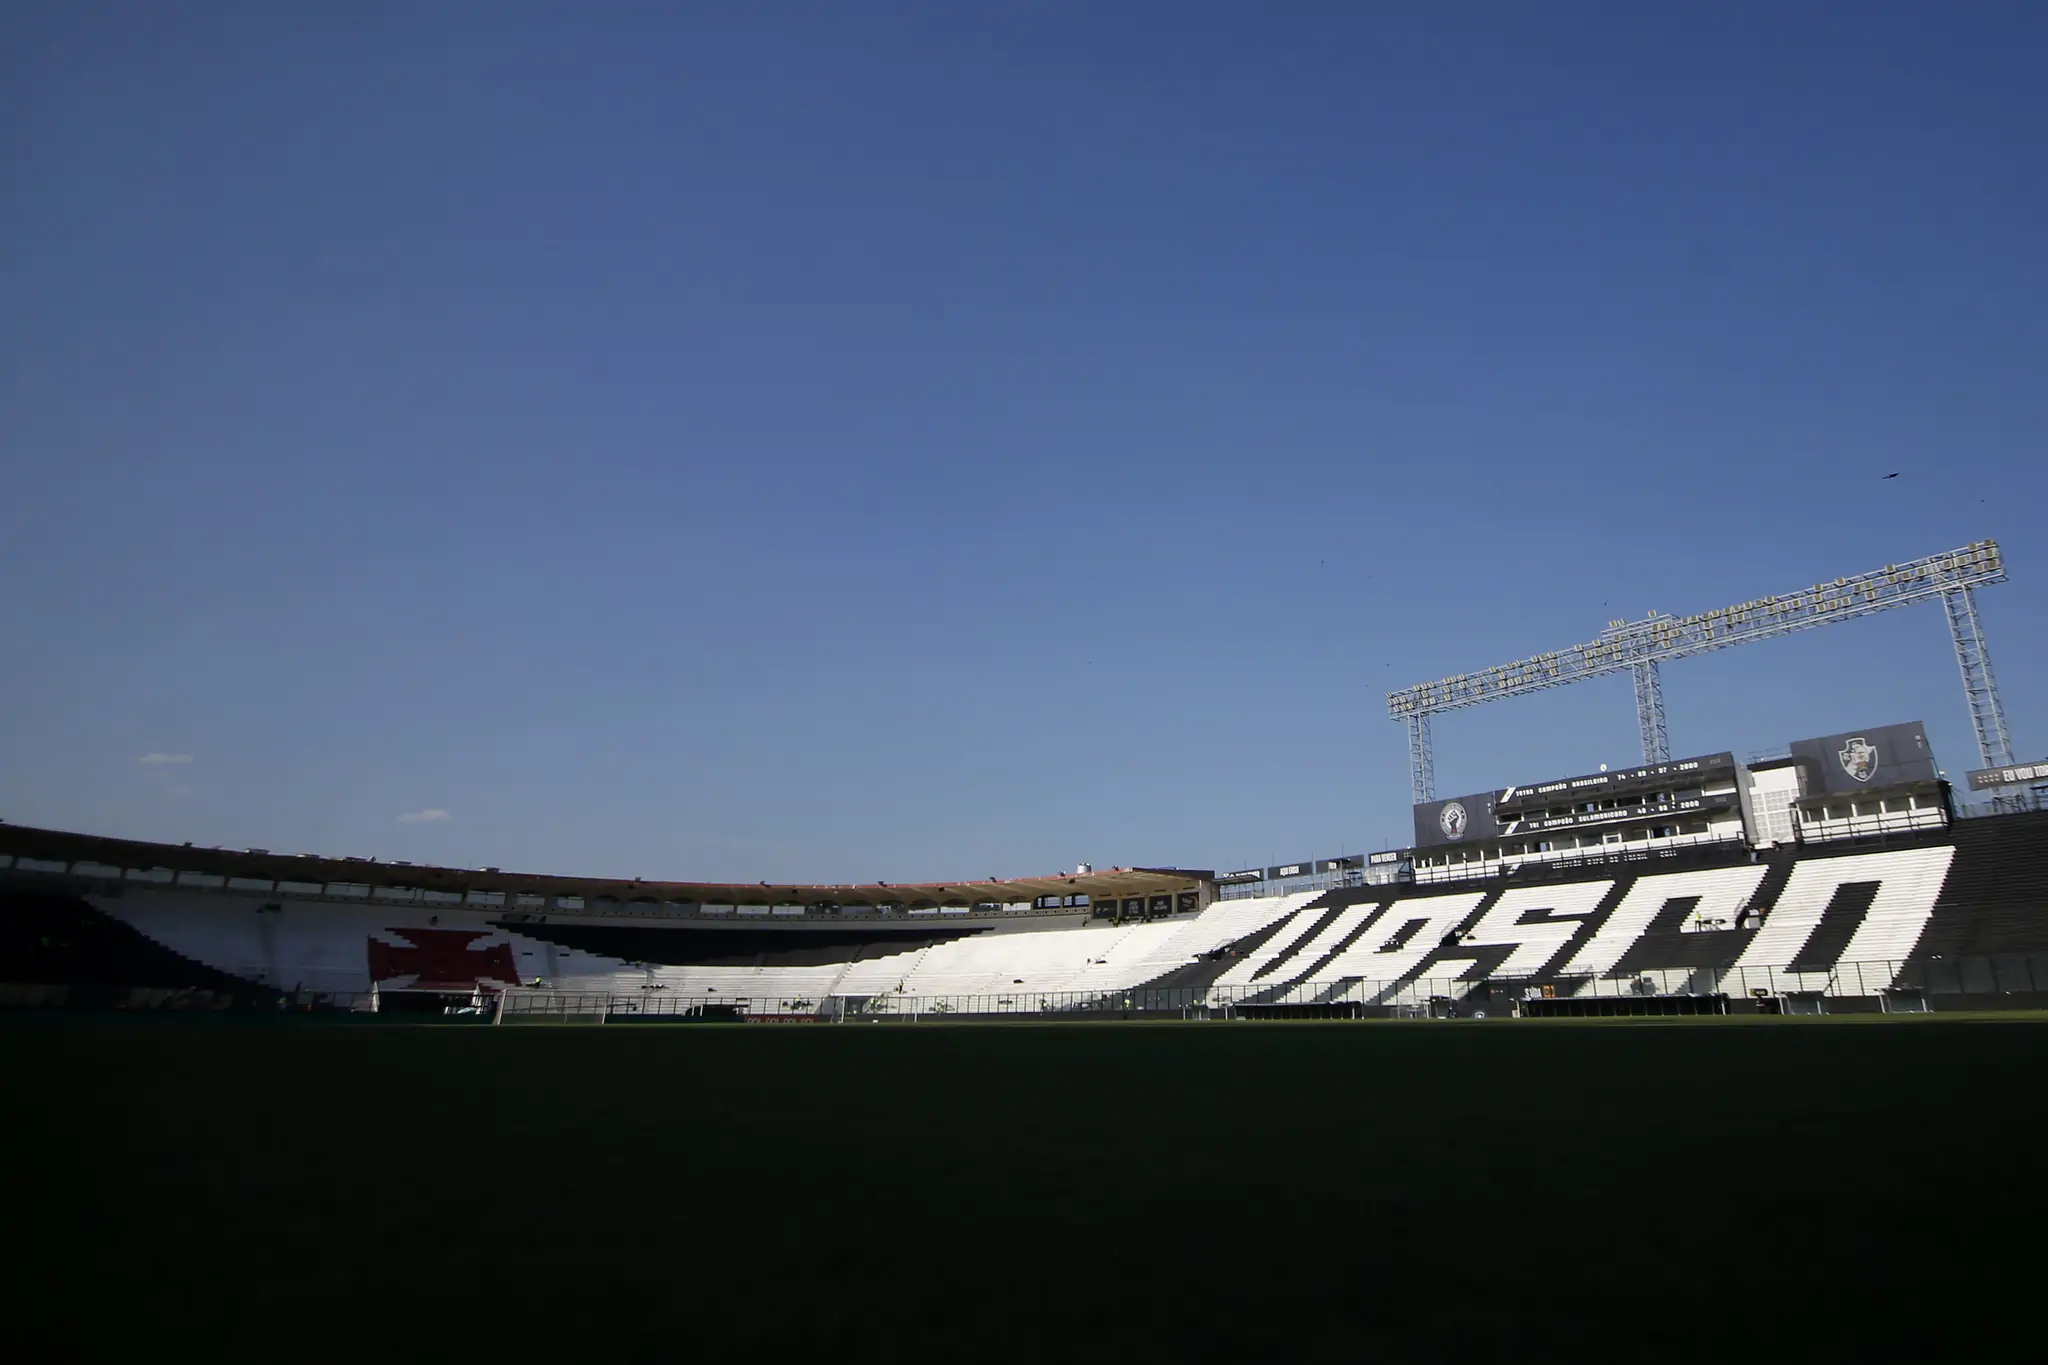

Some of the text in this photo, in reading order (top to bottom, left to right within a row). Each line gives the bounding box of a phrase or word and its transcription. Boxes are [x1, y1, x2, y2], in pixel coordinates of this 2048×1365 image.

[1572, 777, 1608, 788] BRASILEIRO
[1679, 761, 1699, 771] 2000
[2002, 769, 2016, 782] EU
[2014, 766, 2035, 780] VOU
[1578, 810, 1628, 822] SULAMERICANO
[1680, 800, 1700, 809] 2000
[1205, 846, 1957, 1004] VASCO
